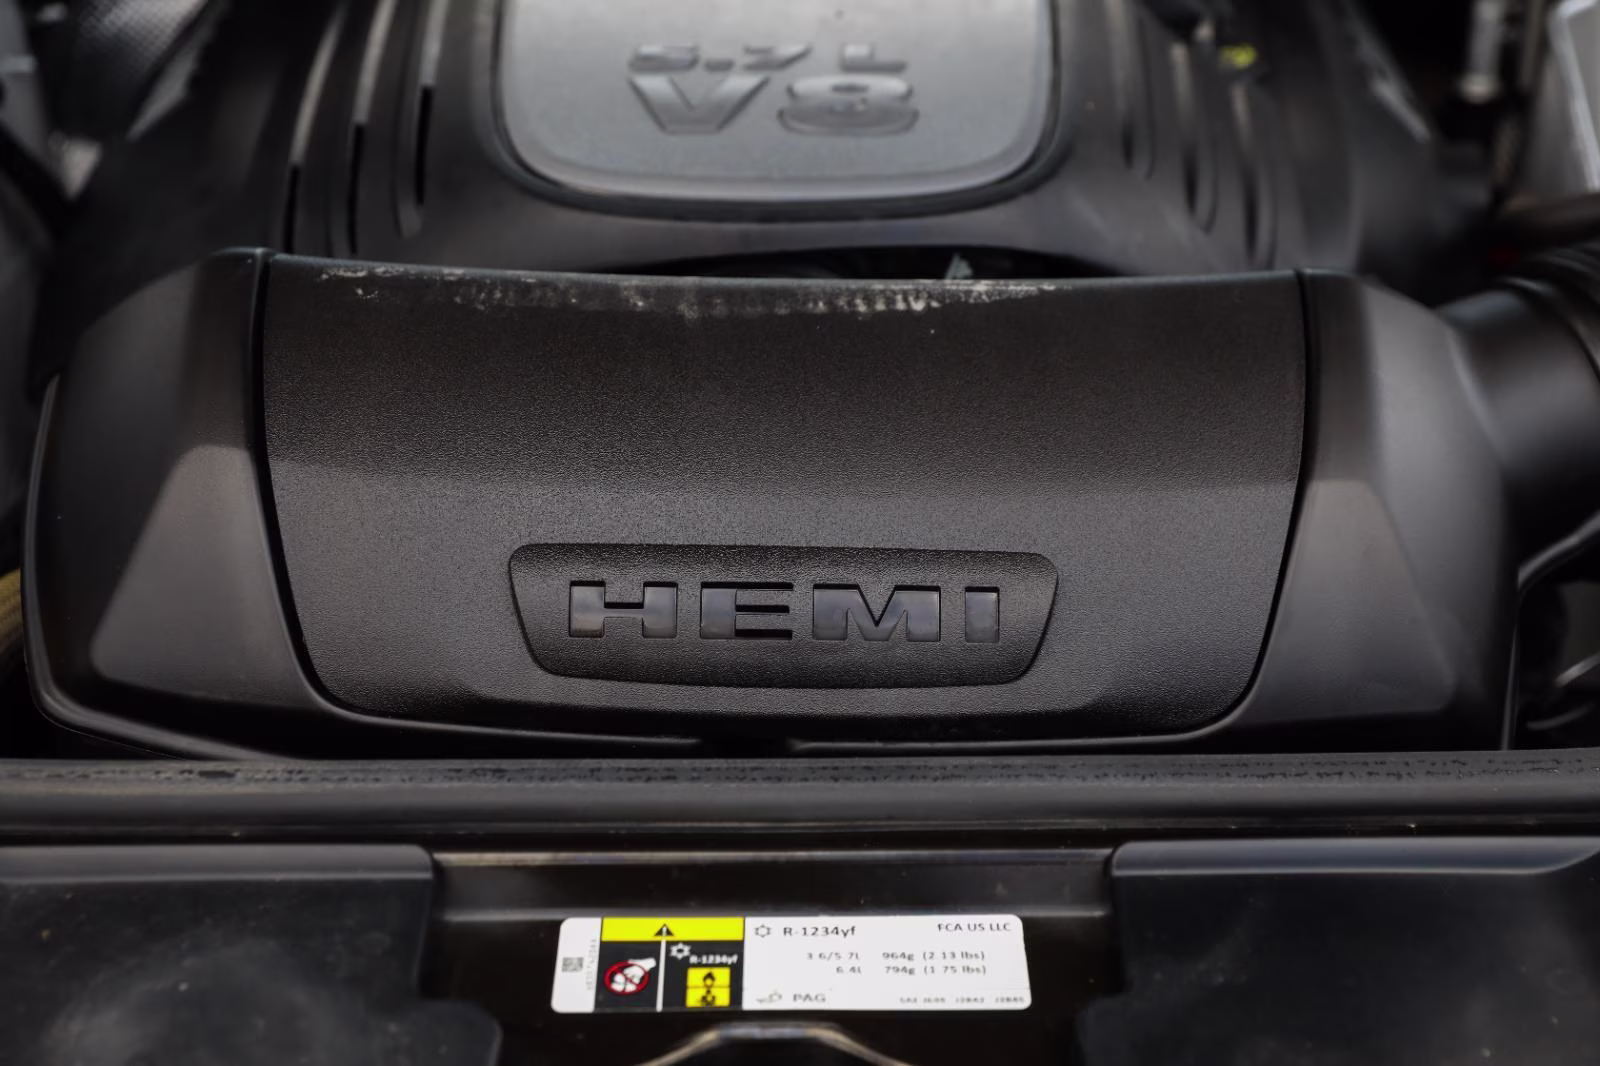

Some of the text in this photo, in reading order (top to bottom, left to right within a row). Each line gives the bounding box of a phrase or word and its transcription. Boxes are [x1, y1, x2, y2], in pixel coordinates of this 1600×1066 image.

[625, 73, 920, 136] V8
[569, 580, 1001, 643] HEMI
[782, 925, 857, 939] R-1234yf
[937, 922, 1012, 932] FCA US LLC
[688, 953, 739, 966] R-1234yf
[806, 950, 985, 962] 36/57L 964g (213 lbs)
[835, 965, 987, 976] 64L 794g (175 lbs)
[792, 993, 827, 1003] PAG
